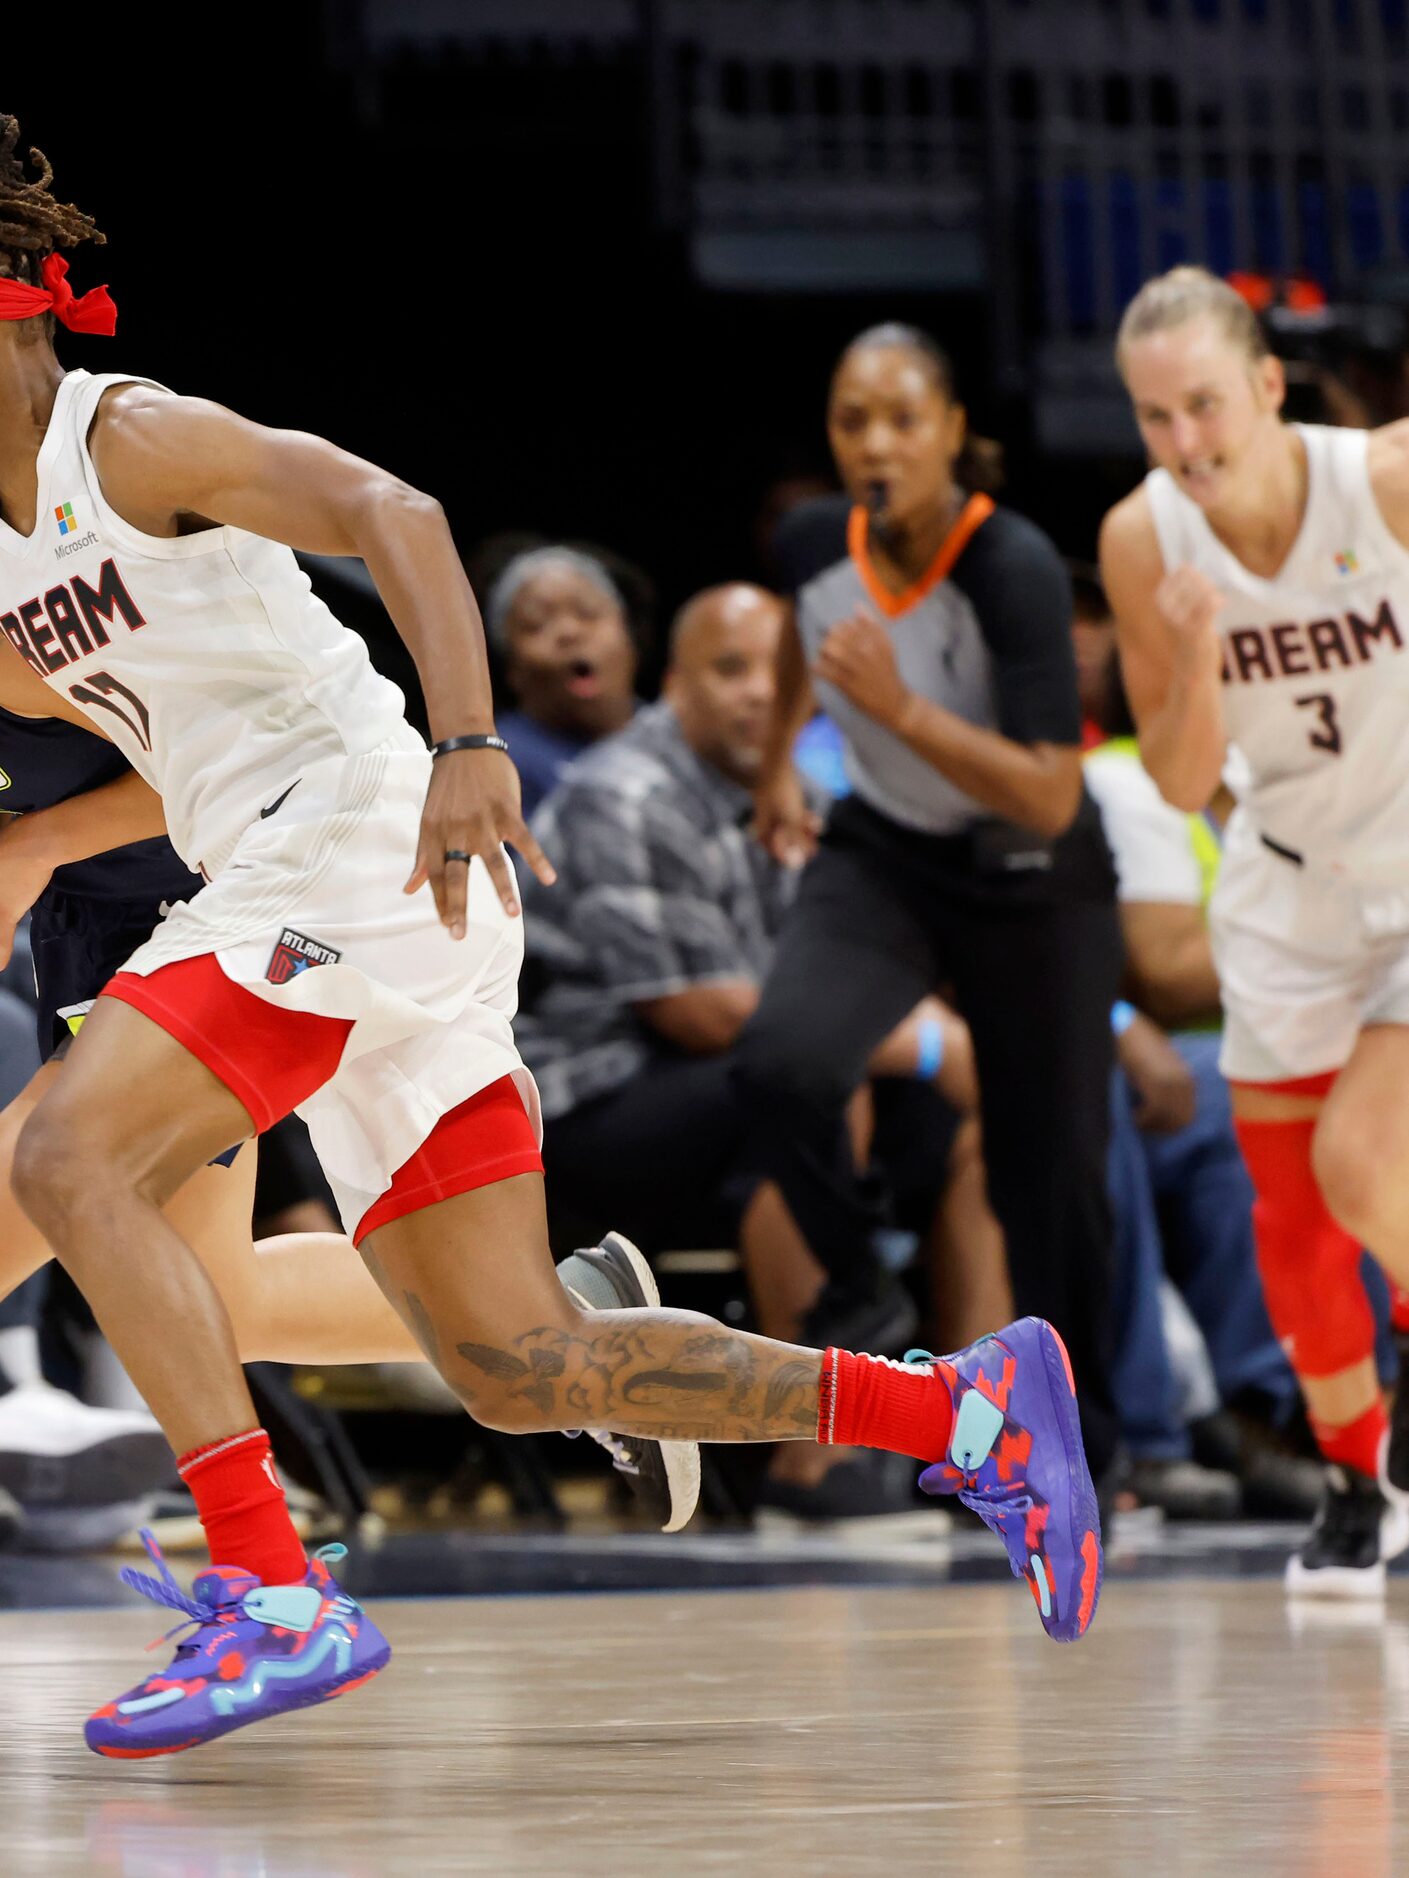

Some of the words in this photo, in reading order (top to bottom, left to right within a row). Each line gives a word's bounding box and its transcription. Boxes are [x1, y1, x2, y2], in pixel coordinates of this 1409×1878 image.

[53, 531, 99, 560] Microsoft
[68, 671, 152, 752] 17
[1294, 694, 1342, 754] 3
[281, 930, 338, 965] ATLANTA
